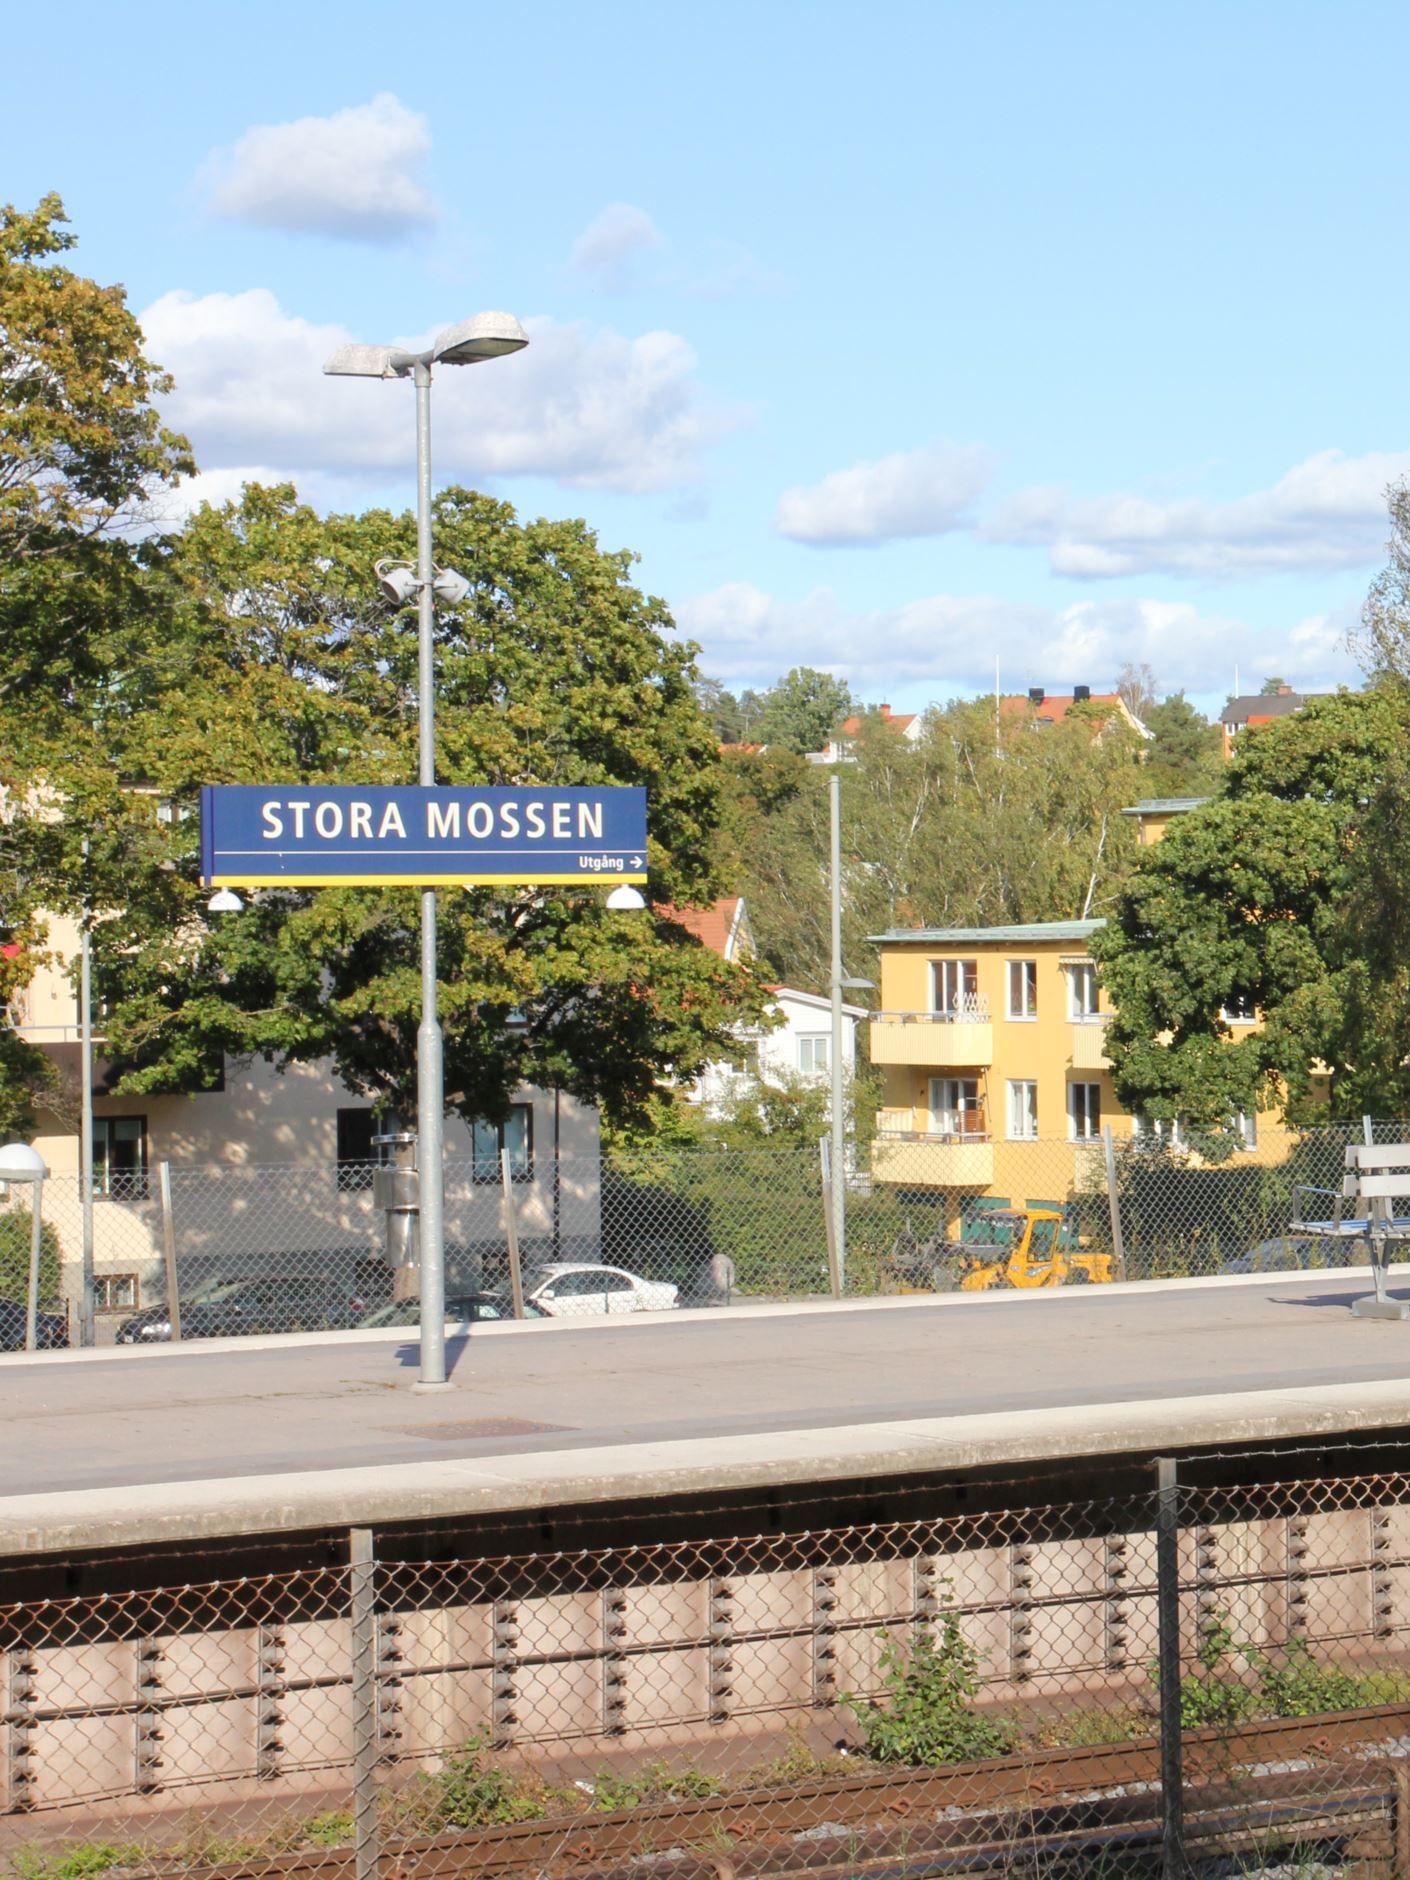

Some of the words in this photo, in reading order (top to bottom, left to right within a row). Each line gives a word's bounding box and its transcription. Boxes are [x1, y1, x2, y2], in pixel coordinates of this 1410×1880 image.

[261, 801, 407, 839] STORA
[427, 801, 604, 839] MOSSEN
[579, 854, 624, 872] Utgång
